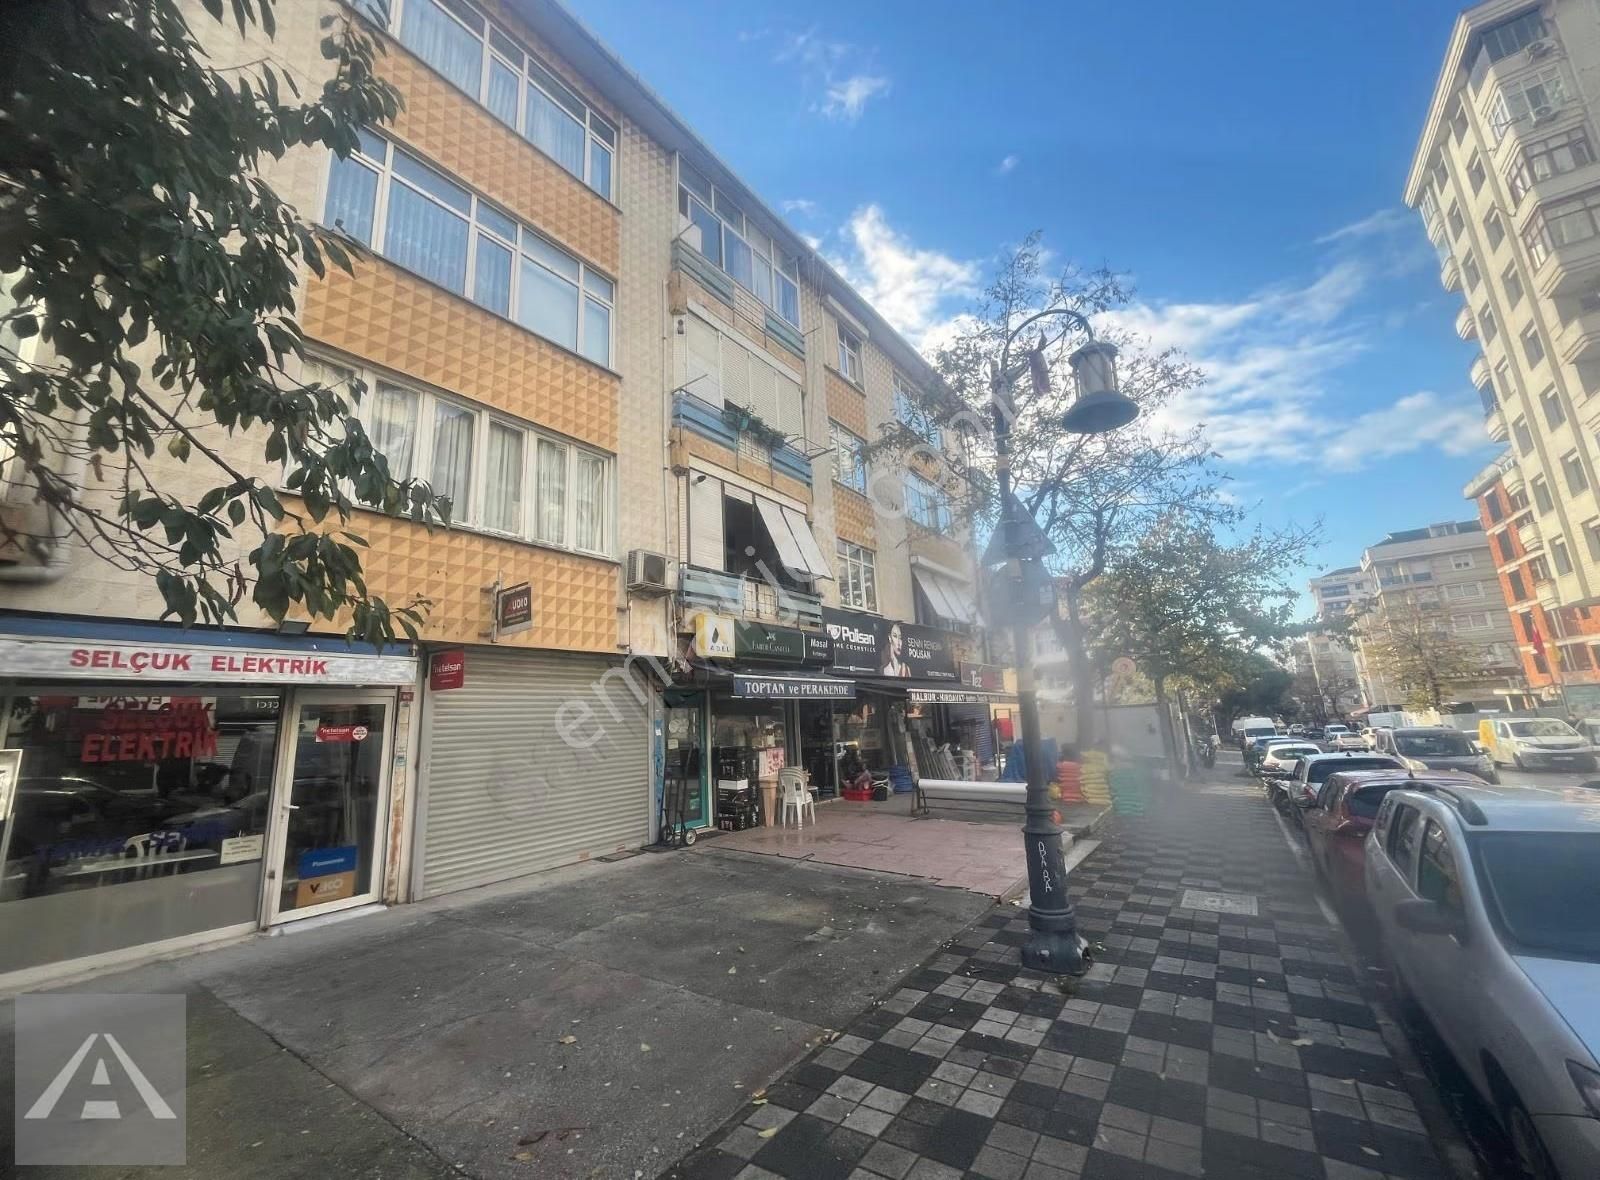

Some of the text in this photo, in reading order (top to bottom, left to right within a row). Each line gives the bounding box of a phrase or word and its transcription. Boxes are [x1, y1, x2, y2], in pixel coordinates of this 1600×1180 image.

[841, 626, 876, 645] Polisan
[710, 644, 730, 652] ADEL
[810, 638, 828, 649] Masal
[70, 648, 327, 675] SELÇUK ELEKTRİK
[745, 682, 849, 695] TOPTAN ve PERAKENDE
